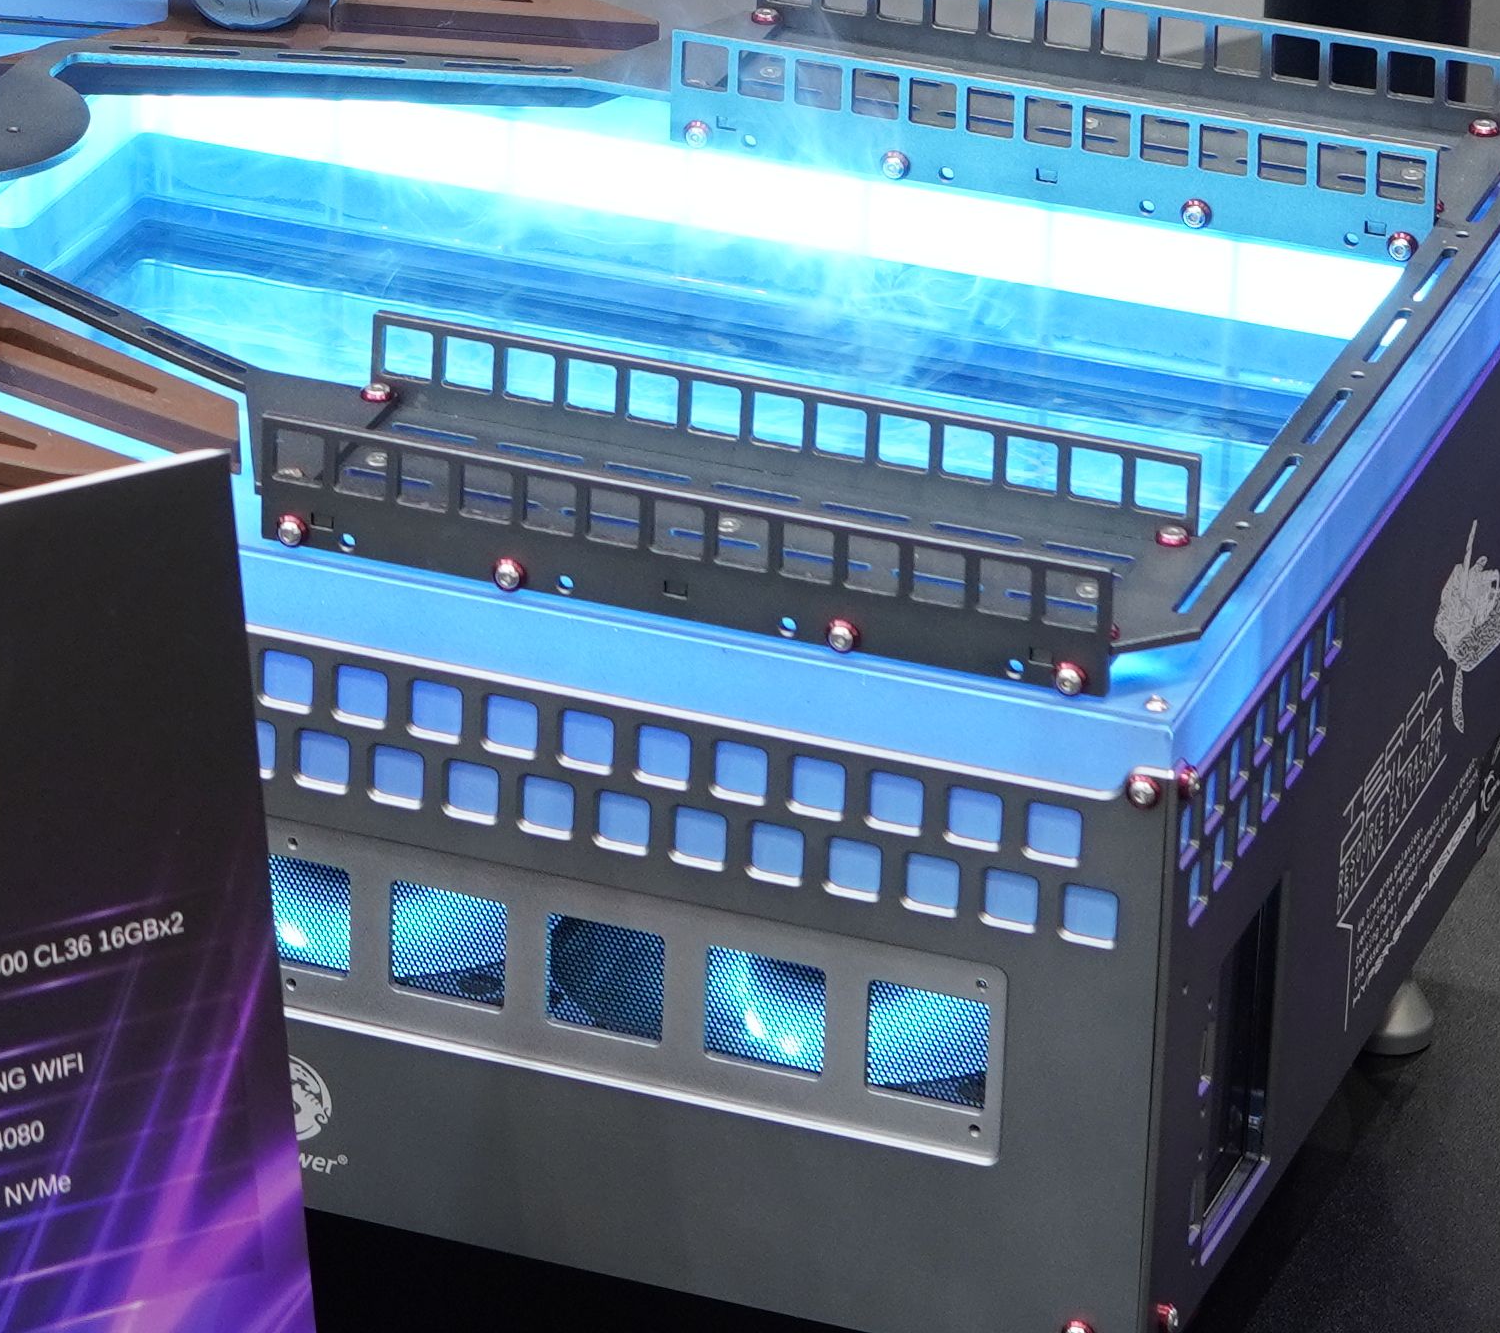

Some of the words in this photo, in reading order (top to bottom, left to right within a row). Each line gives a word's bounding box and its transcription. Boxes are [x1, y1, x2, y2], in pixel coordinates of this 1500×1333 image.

[1339, 804, 1385, 891] RESOURCE
[1389, 717, 1442, 813] EXTRACTOR
[1340, 708, 1443, 866] DRILL
[1343, 666, 1444, 823] TERRA
[1336, 828, 1383, 915] DRILLING
[1389, 739, 1440, 833] PLATFORM
[34, 934, 92, 969] CL36
[99, 911, 184, 953] 16GBx2
[33, 1052, 84, 1085] WIFI
[4, 1173, 71, 1207] NVMe
